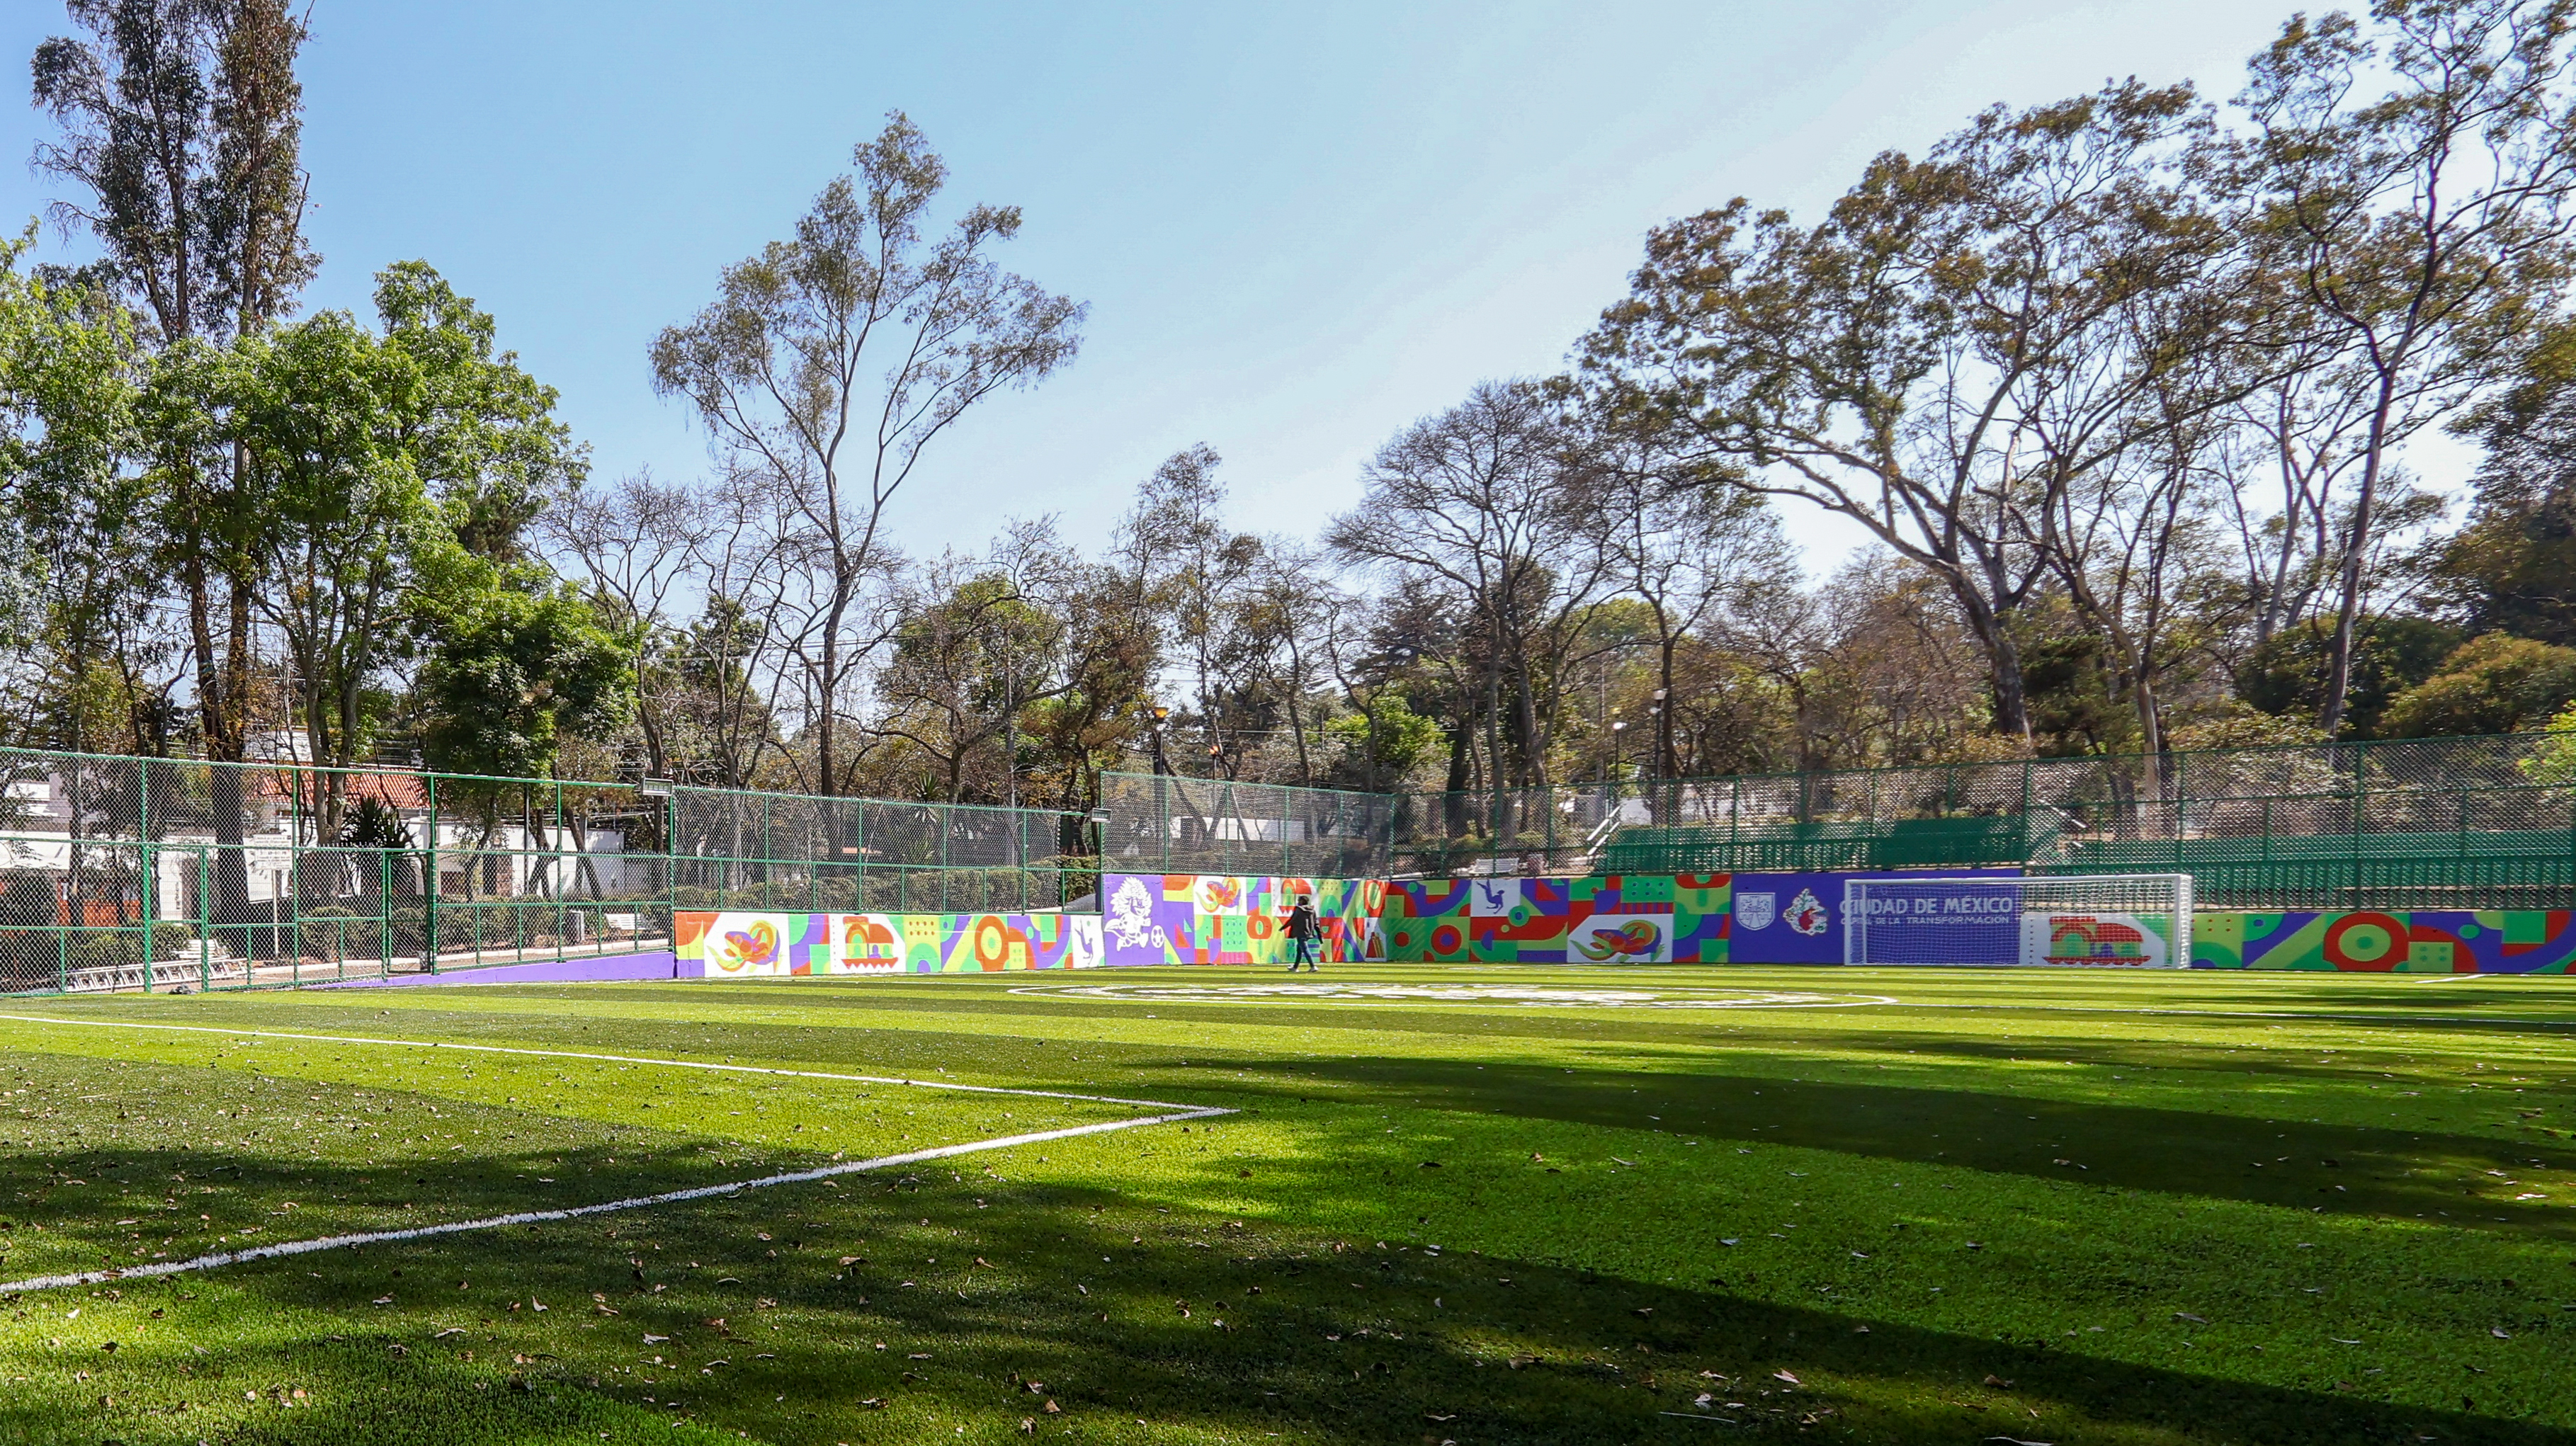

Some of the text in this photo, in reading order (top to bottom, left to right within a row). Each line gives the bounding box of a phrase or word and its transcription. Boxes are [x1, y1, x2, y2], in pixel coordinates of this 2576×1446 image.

[1914, 899, 1937, 913] DE
[1944, 895, 2012, 913] MÉXICO
[1907, 915, 2009, 924] TRANSFORMACIÓN
